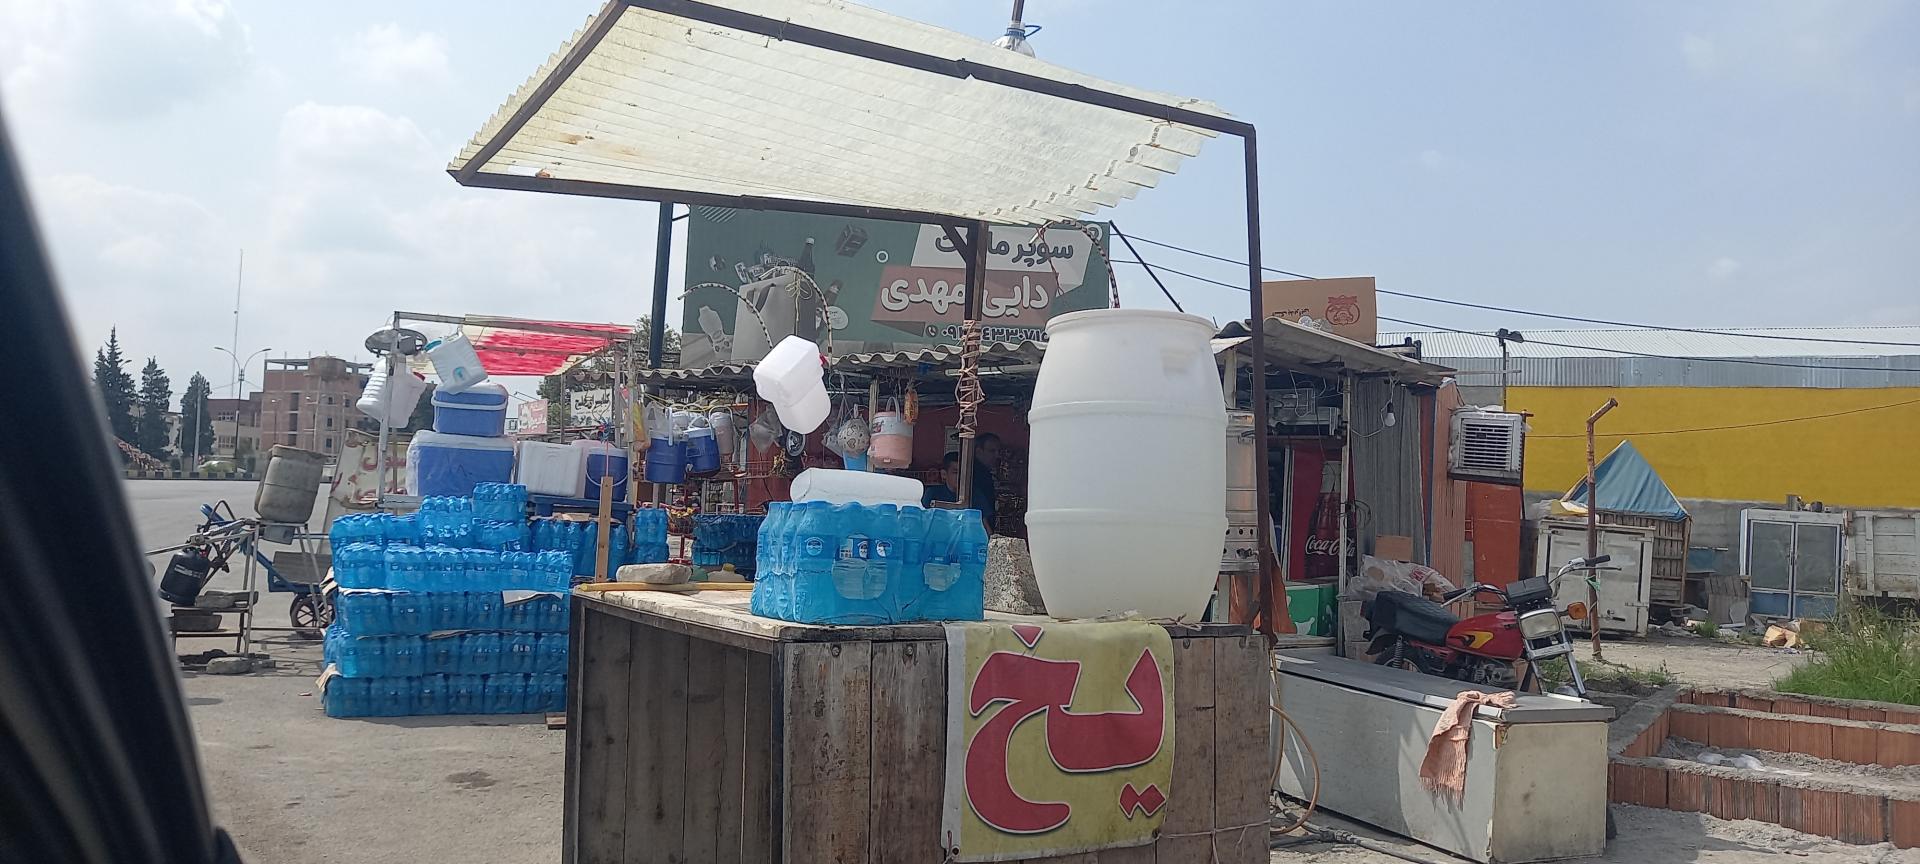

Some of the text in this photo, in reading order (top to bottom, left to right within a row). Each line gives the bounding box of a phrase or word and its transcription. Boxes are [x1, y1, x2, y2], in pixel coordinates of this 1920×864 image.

[935, 230, 1010, 256] مات
[881, 275, 1050, 318] دایی مهدی
[964, 624, 1167, 835] یخ
